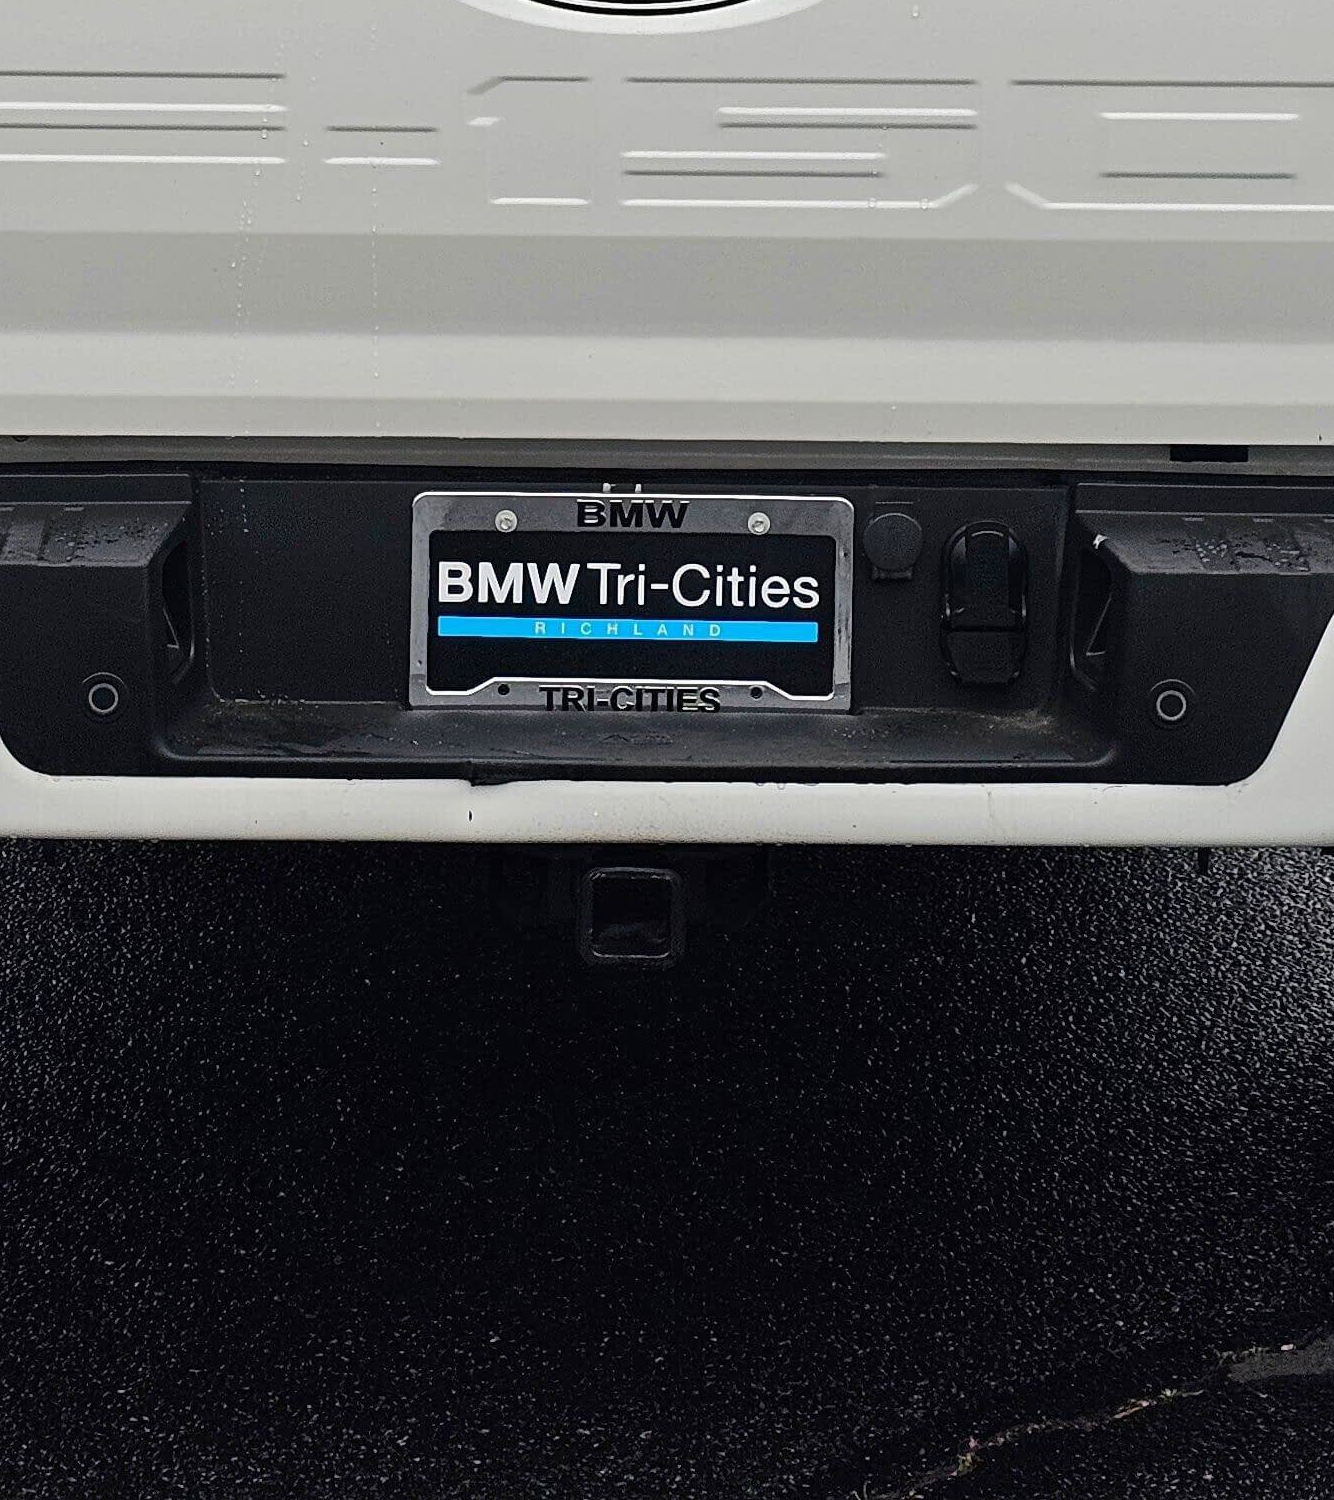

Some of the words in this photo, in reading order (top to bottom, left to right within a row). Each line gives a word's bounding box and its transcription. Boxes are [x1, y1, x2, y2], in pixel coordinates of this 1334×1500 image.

[577, 499, 690, 529] BMW
[438, 561, 581, 604] BMW
[586, 562, 820, 609] Tri-Cities
[534, 621, 722, 637] RICHLAND
[539, 684, 721, 712] TRI-CITIES
